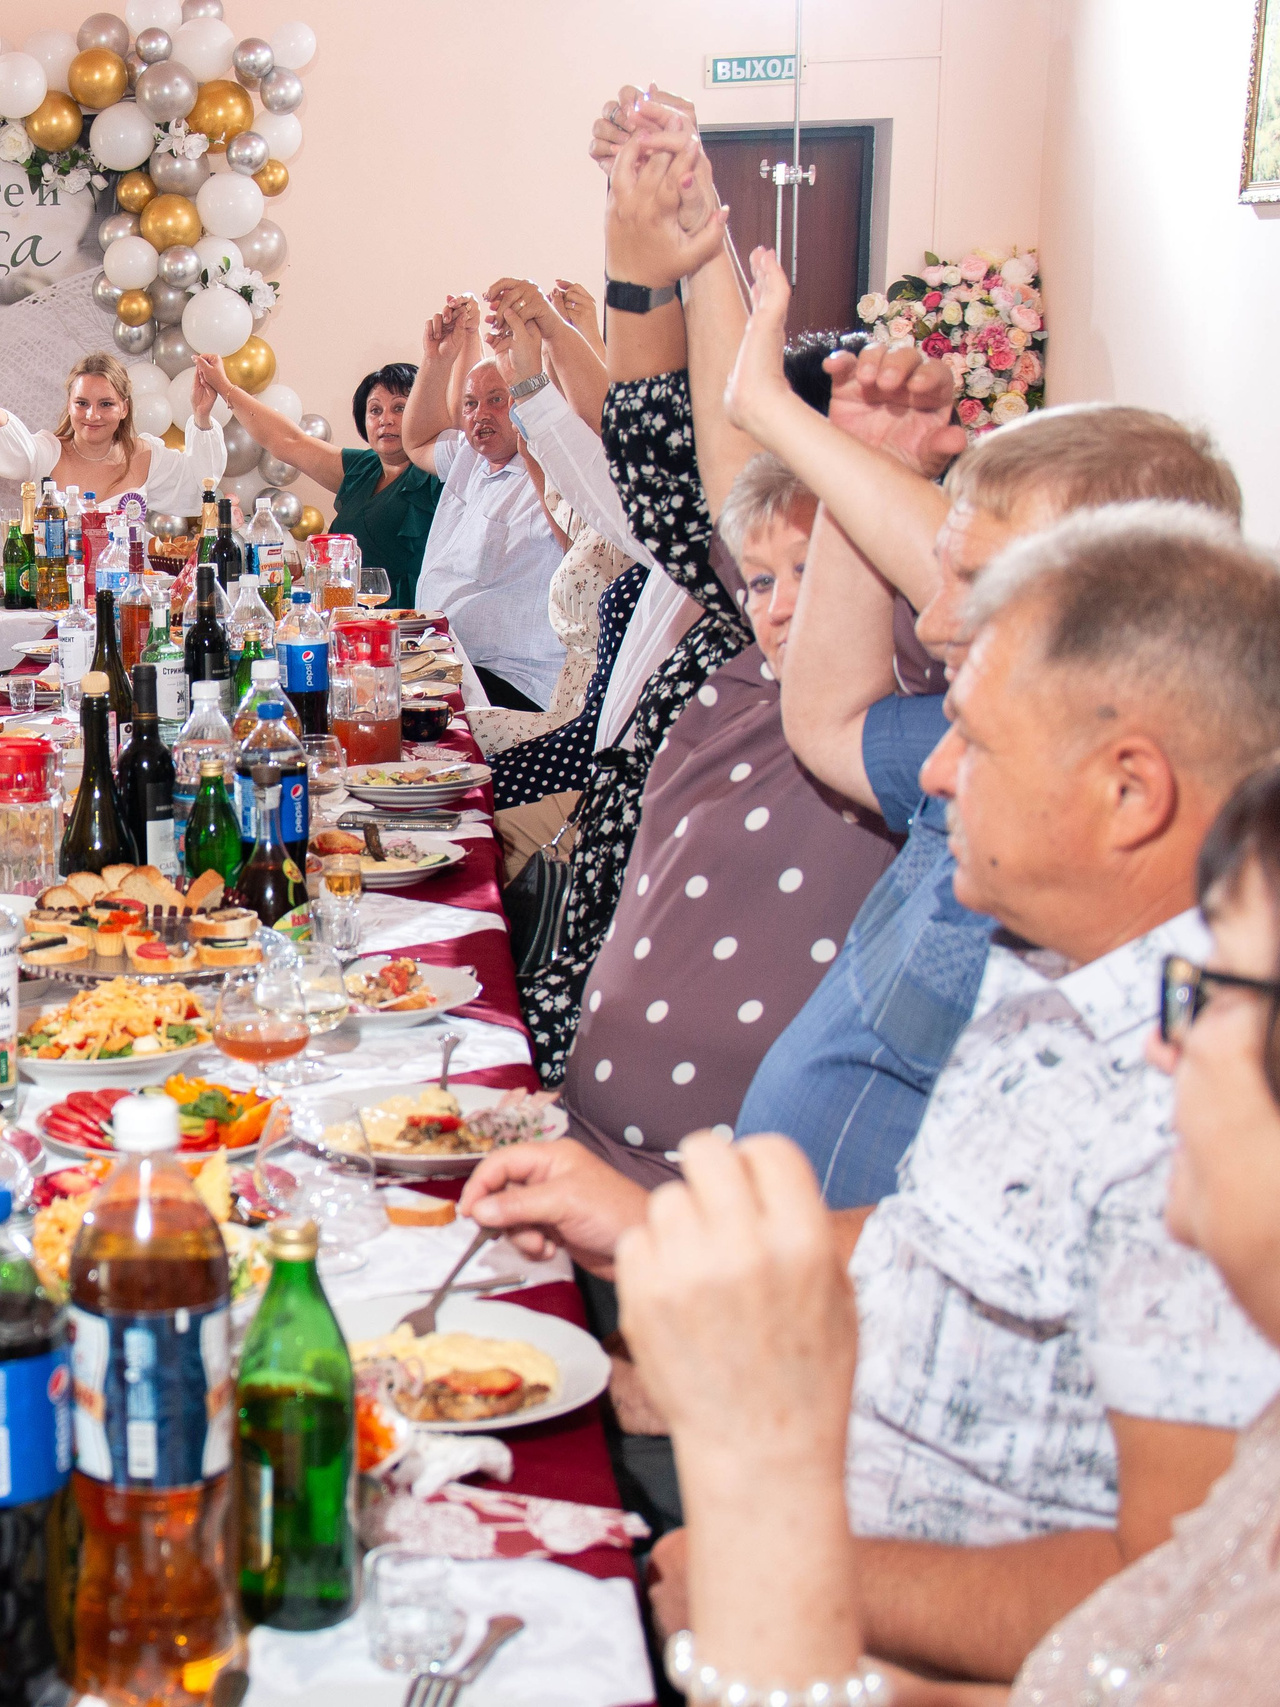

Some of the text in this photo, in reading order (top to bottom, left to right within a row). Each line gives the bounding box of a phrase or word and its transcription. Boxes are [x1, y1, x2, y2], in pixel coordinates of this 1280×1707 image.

[716, 58, 796, 80] ВЫХОД
[304, 663, 314, 687] pepsi
[294, 801, 303, 834] pepsi
